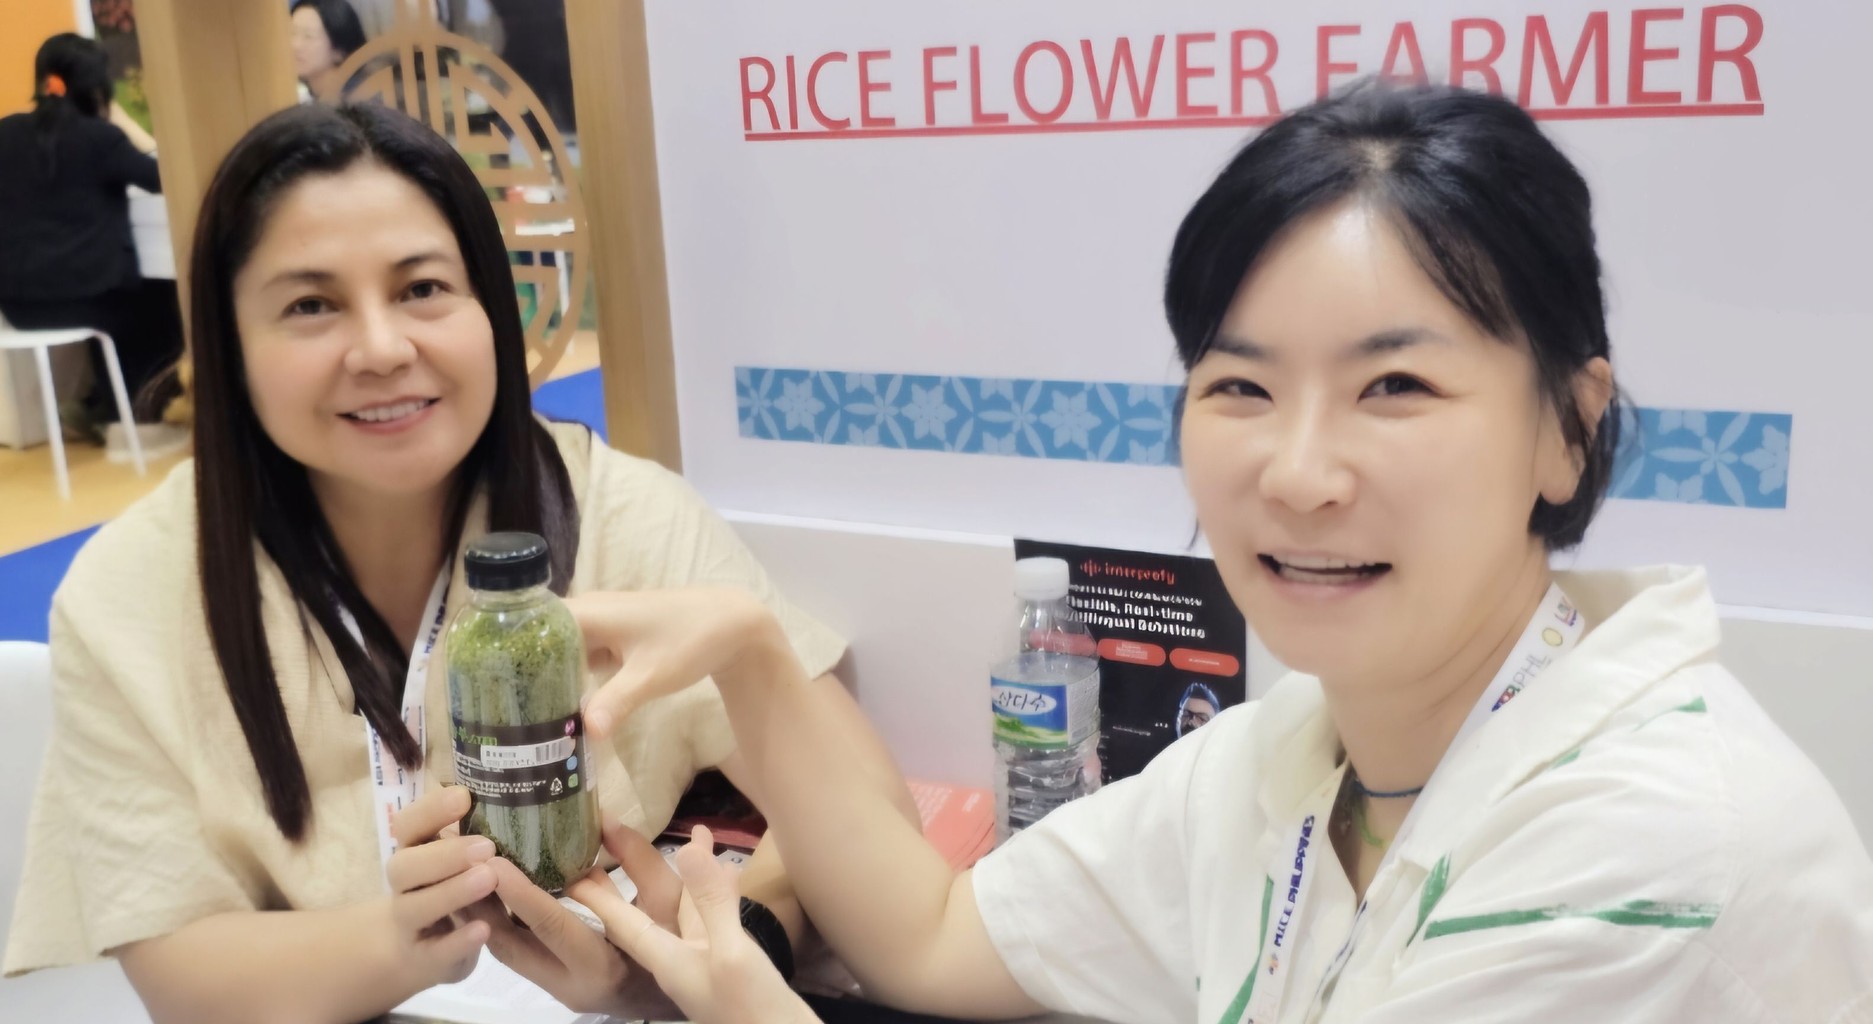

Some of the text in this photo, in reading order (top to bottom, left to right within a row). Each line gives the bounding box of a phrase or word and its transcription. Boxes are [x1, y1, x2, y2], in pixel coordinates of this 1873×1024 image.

[739, 4, 1764, 131] RICE FLOWER FARMER
